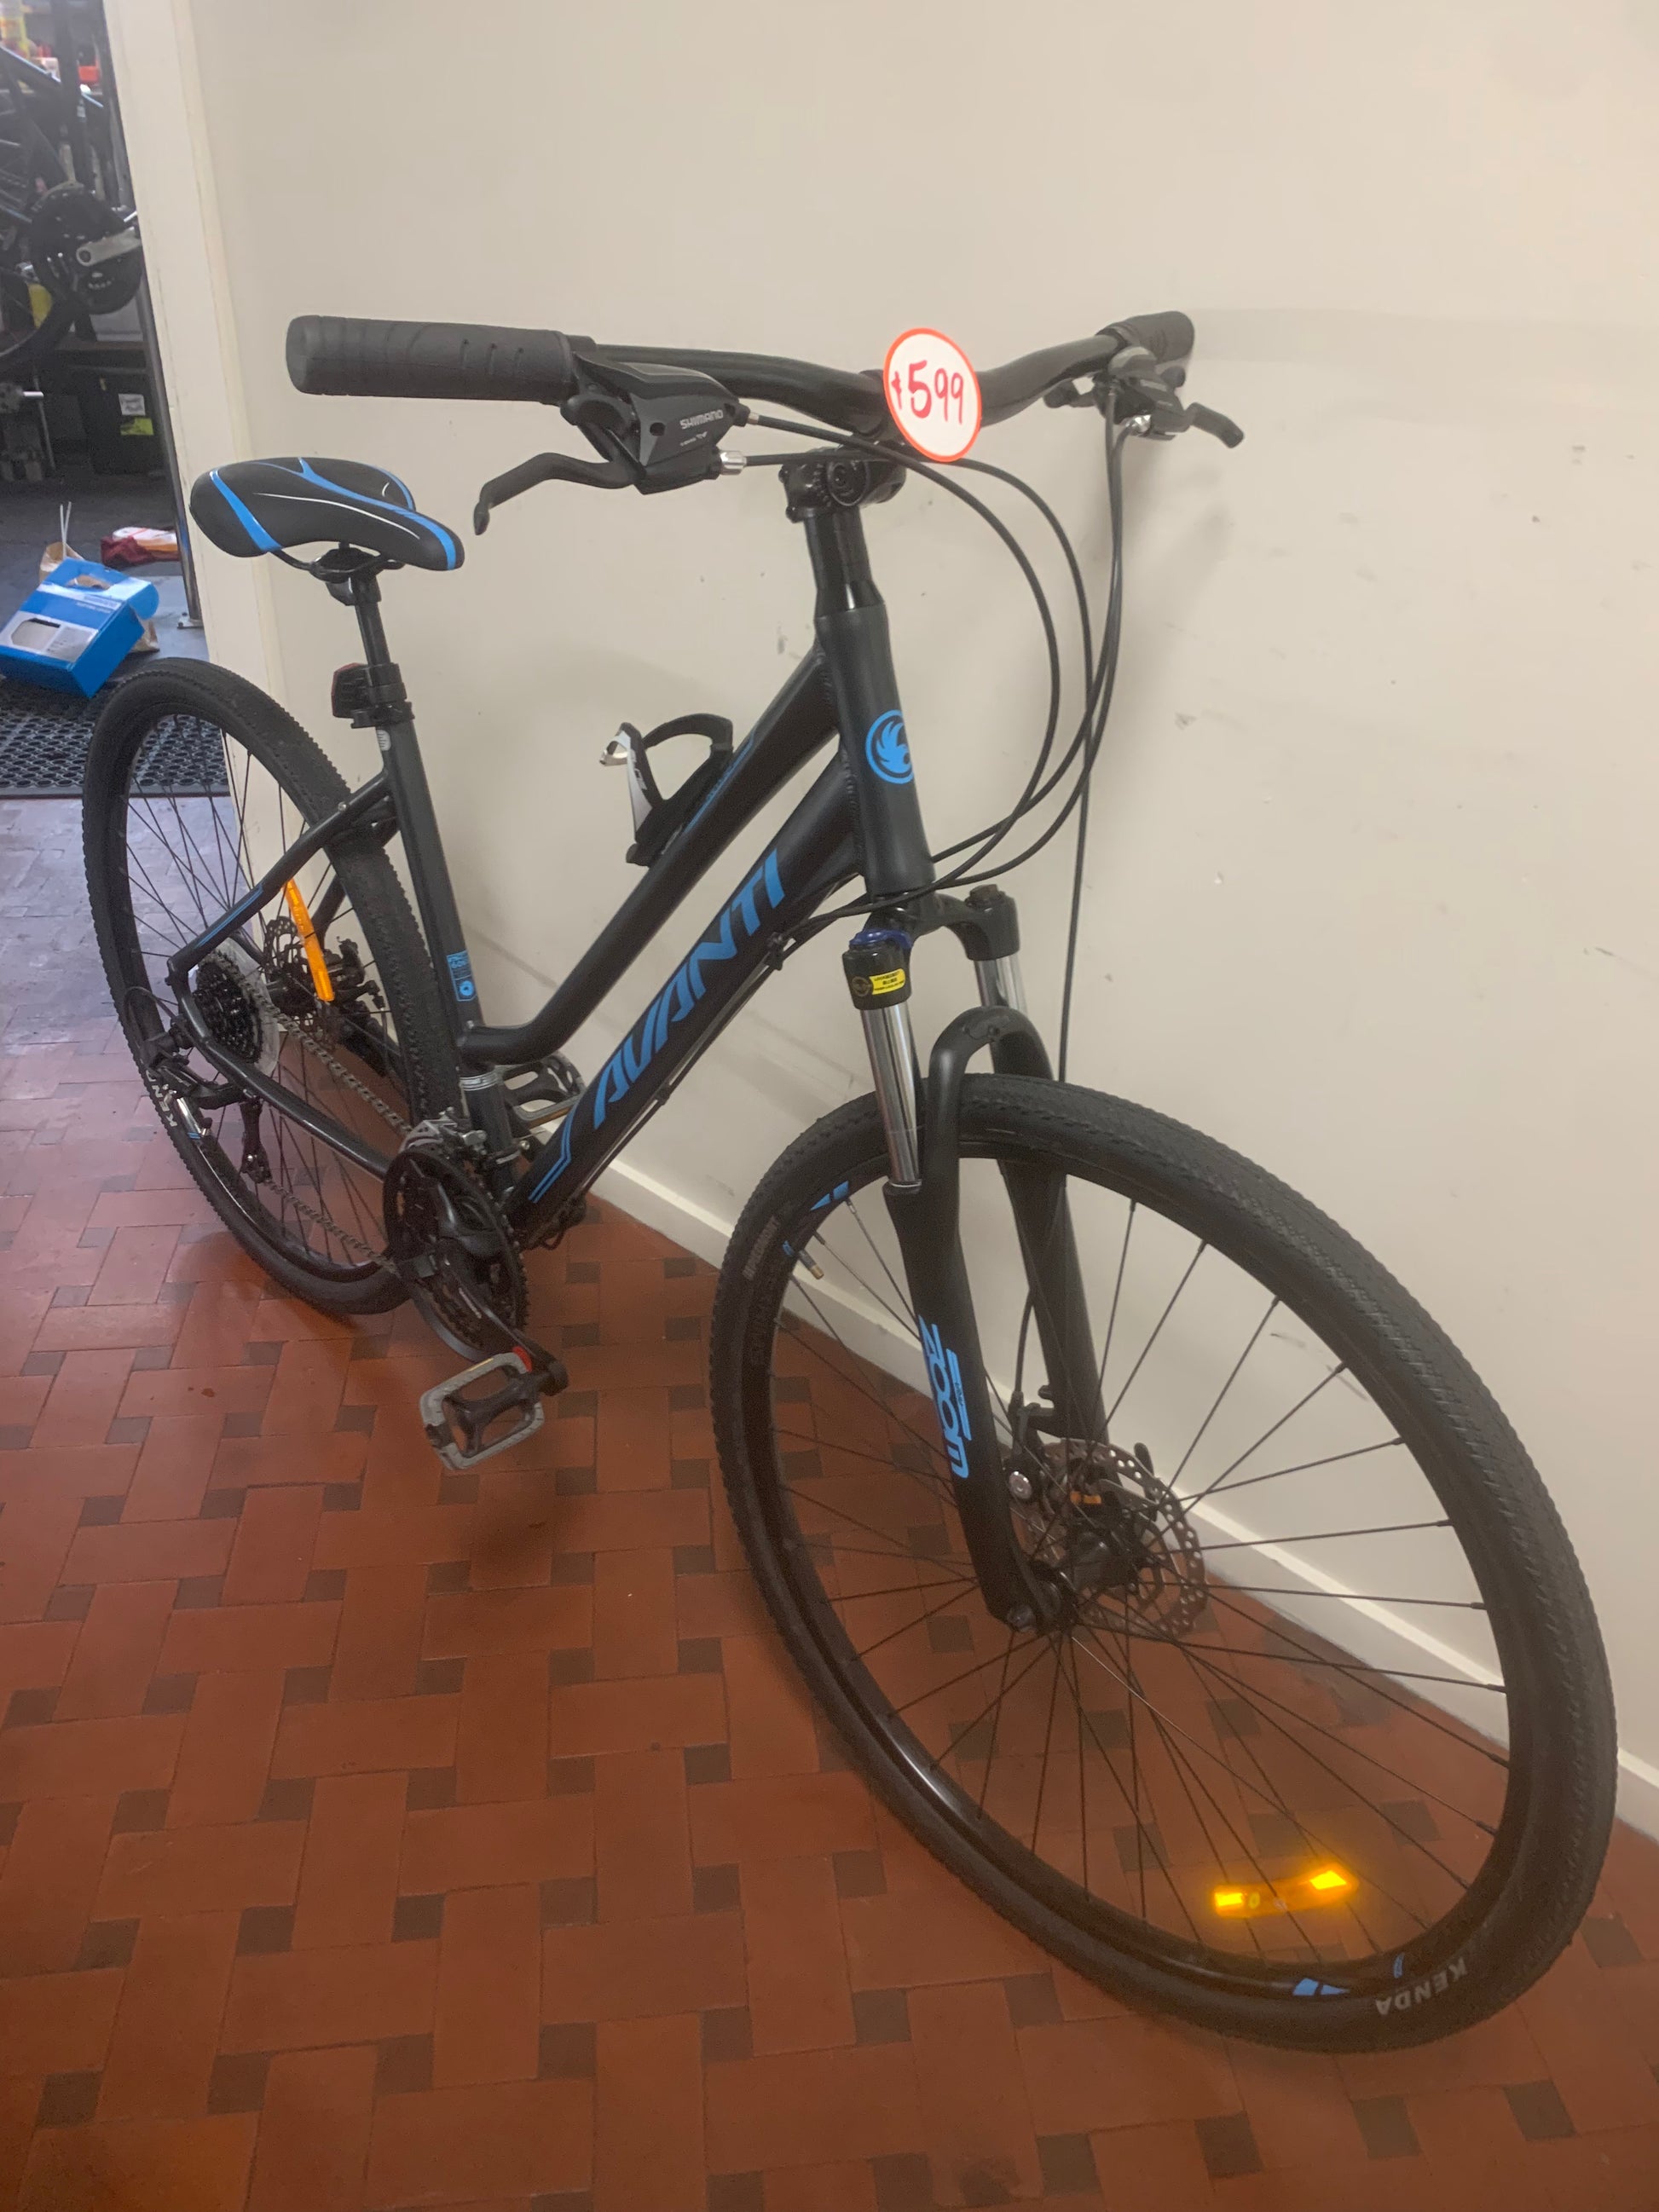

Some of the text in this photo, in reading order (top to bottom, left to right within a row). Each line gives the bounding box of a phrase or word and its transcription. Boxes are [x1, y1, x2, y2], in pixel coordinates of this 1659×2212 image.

[679, 409, 724, 430] SHIMANO
[891, 359, 964, 424] $599
[593, 848, 786, 1129] AVANTI
[1375, 1957, 1468, 2016] KENDA
